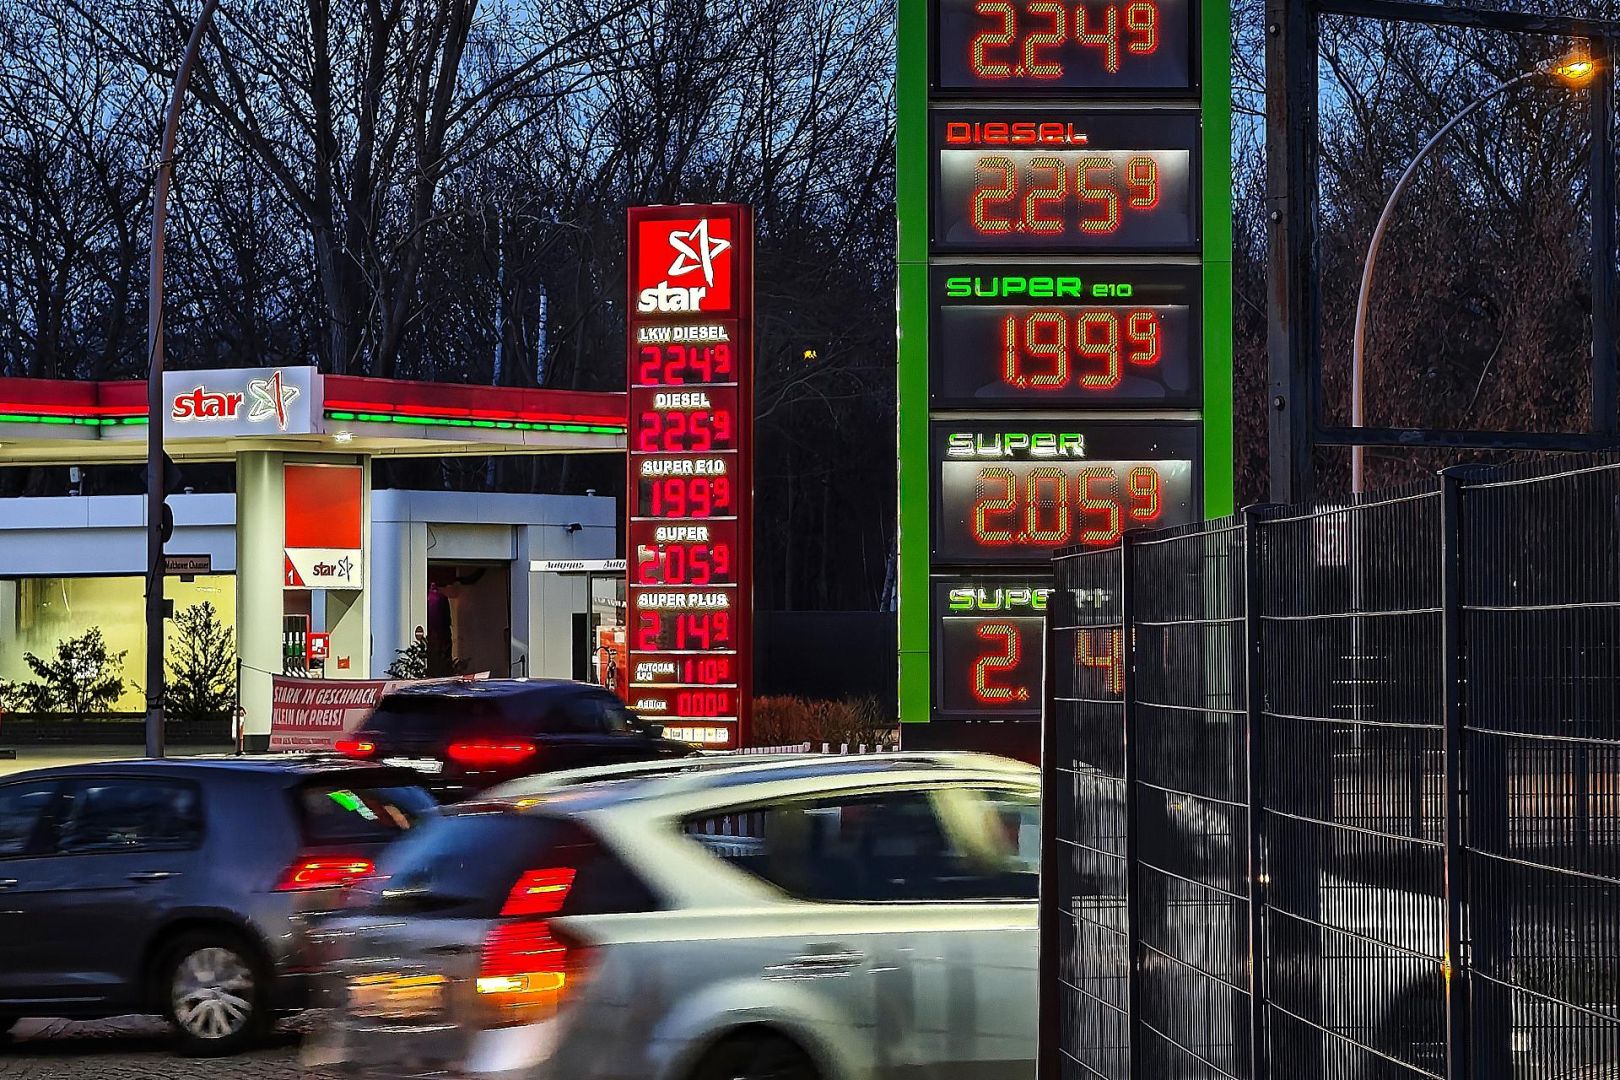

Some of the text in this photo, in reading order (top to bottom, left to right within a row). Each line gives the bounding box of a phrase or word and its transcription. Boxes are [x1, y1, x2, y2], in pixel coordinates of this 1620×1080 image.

[638, 281, 706, 312] star
[639, 326, 728, 341] LKW DIESEL
[172, 386, 245, 420] star
[655, 393, 710, 408] DIESEL
[642, 460, 725, 475] SUPER E10
[656, 526, 709, 541] SUPER
[313, 562, 337, 578] star
[638, 593, 687, 608] SUPER
[688, 593, 728, 607] PLUS
[273, 686, 302, 705] STARK
